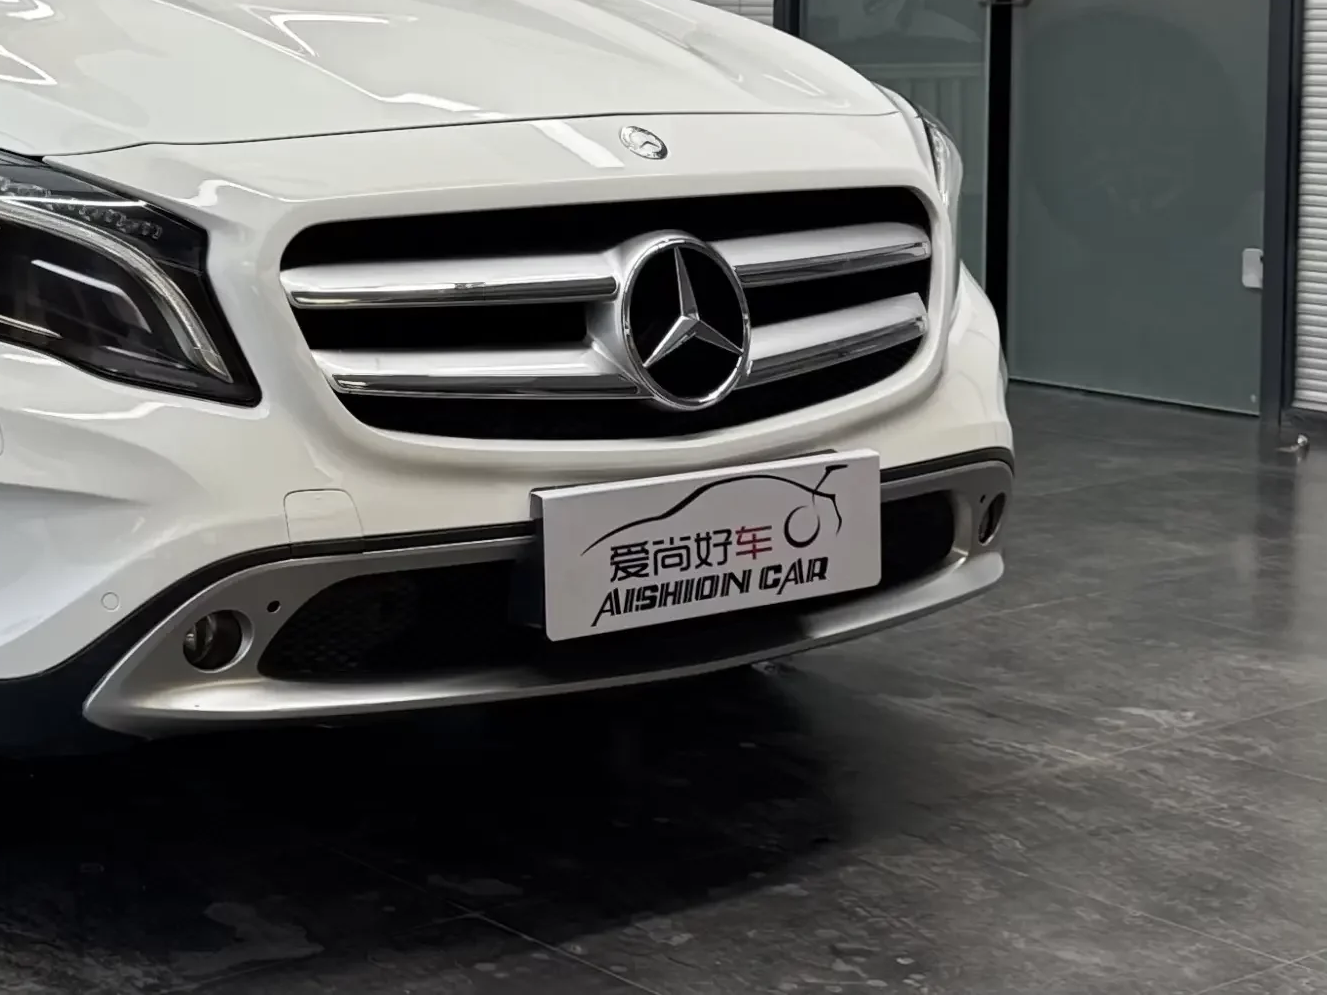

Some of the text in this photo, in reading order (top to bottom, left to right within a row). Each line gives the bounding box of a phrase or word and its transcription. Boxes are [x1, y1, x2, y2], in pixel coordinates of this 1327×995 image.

[609, 525, 773, 583] 爱尚好车
[591, 555, 829, 627] AISHION CAR
